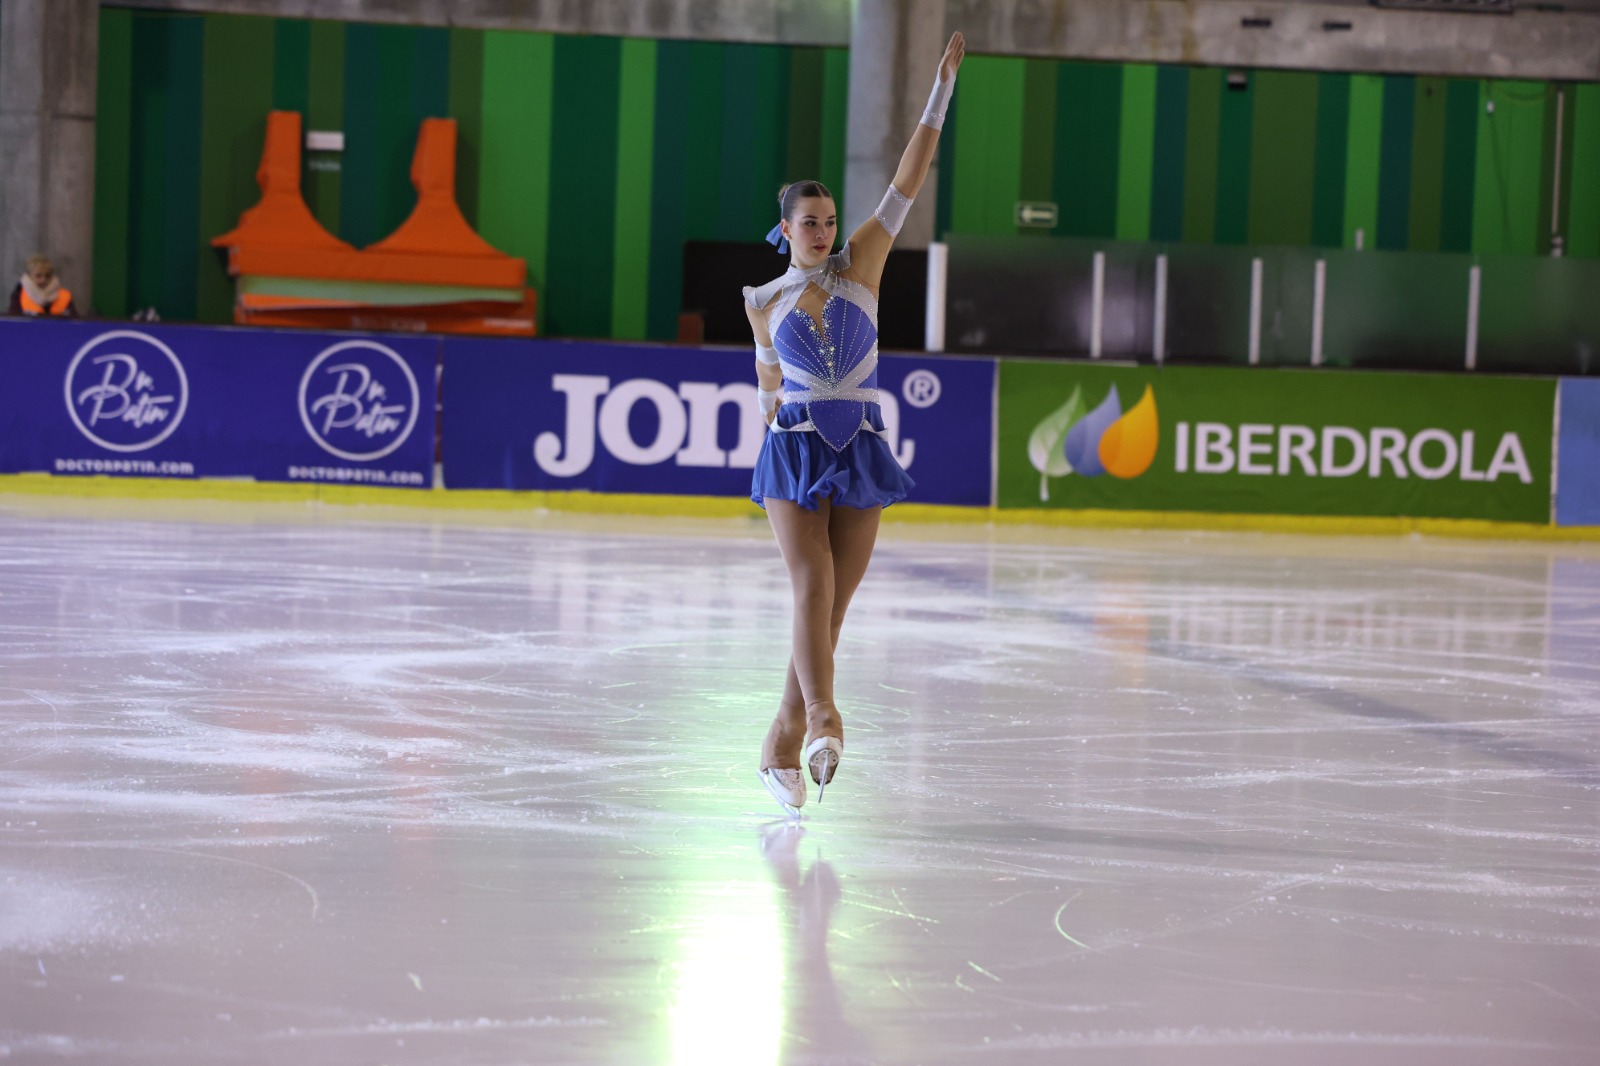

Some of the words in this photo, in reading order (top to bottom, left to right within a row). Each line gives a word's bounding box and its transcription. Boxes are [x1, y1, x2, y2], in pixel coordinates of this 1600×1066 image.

[78, 384, 175, 428] Patin
[311, 393, 406, 438] Patin
[1175, 421, 1533, 483] IBERDROLA
